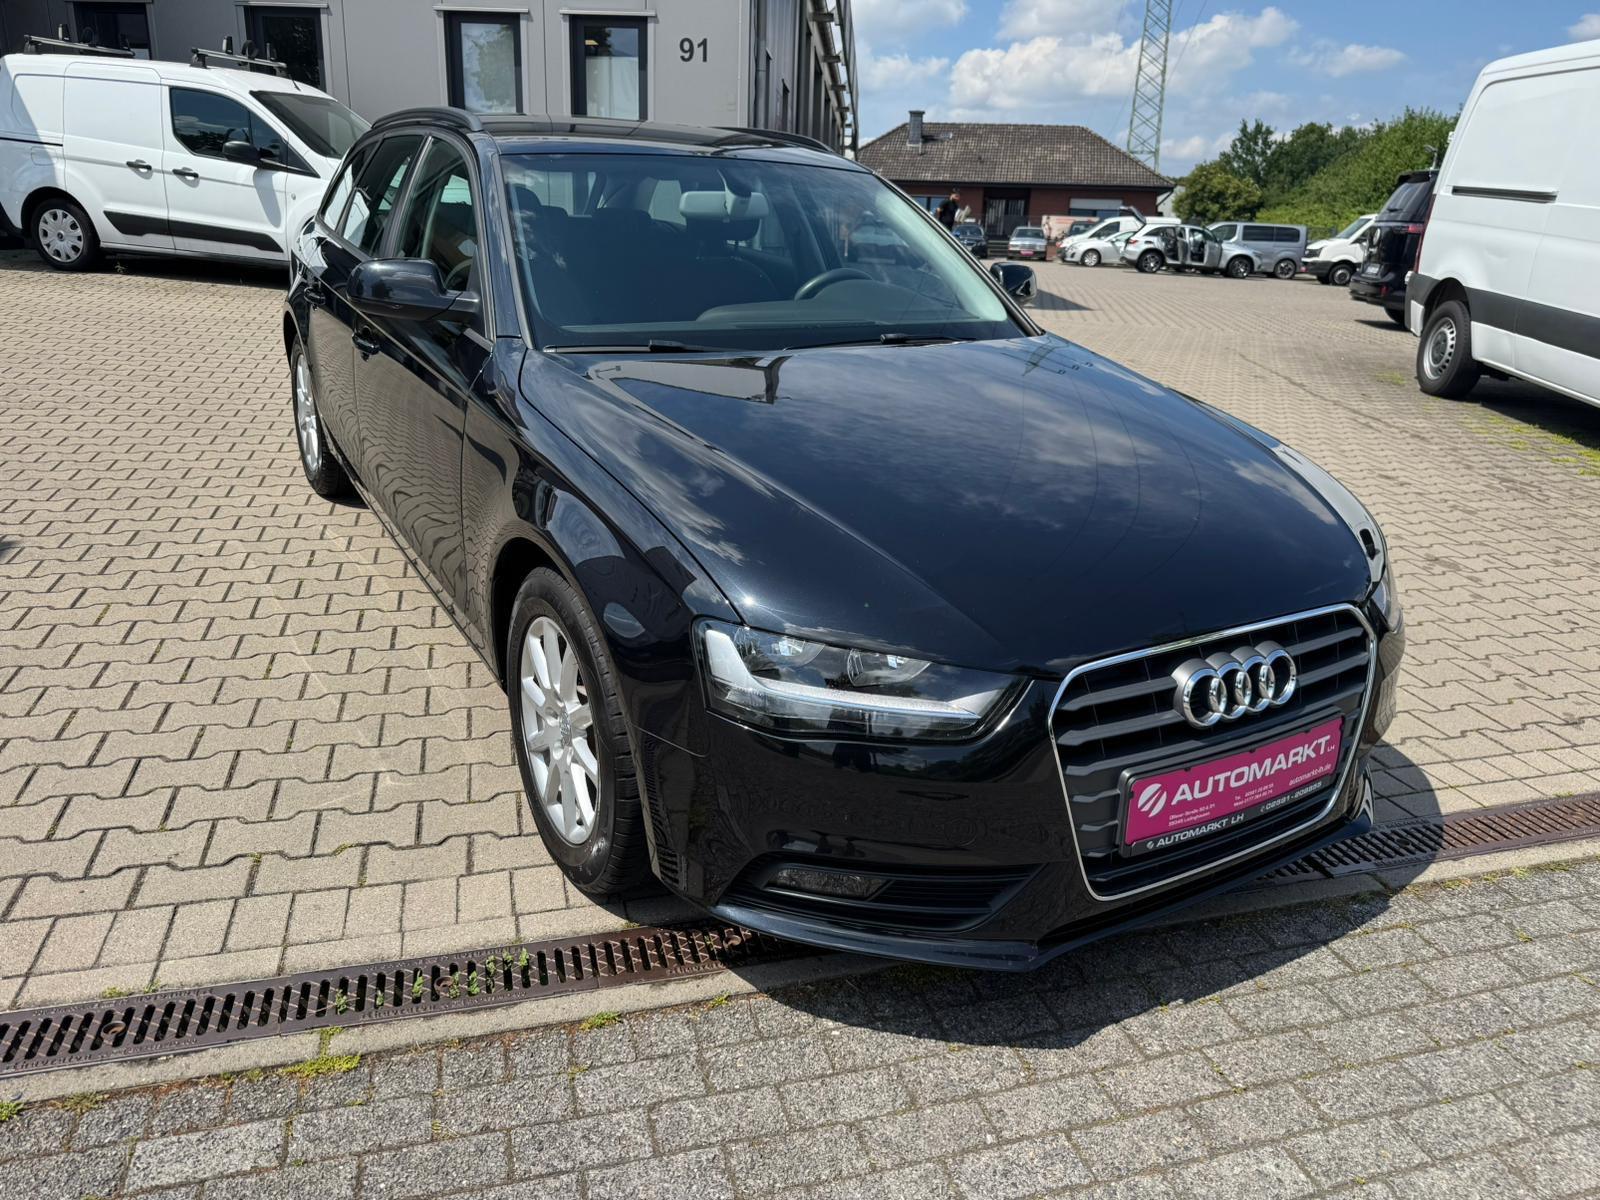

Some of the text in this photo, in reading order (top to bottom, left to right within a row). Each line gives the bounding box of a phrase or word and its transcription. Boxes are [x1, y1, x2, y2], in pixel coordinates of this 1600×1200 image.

[679, 37, 708, 63] 91
[1170, 735, 1331, 806] AUTOMARKT
[1156, 818, 1229, 848] AUTOMARKT
[1231, 813, 1245, 825] LH
